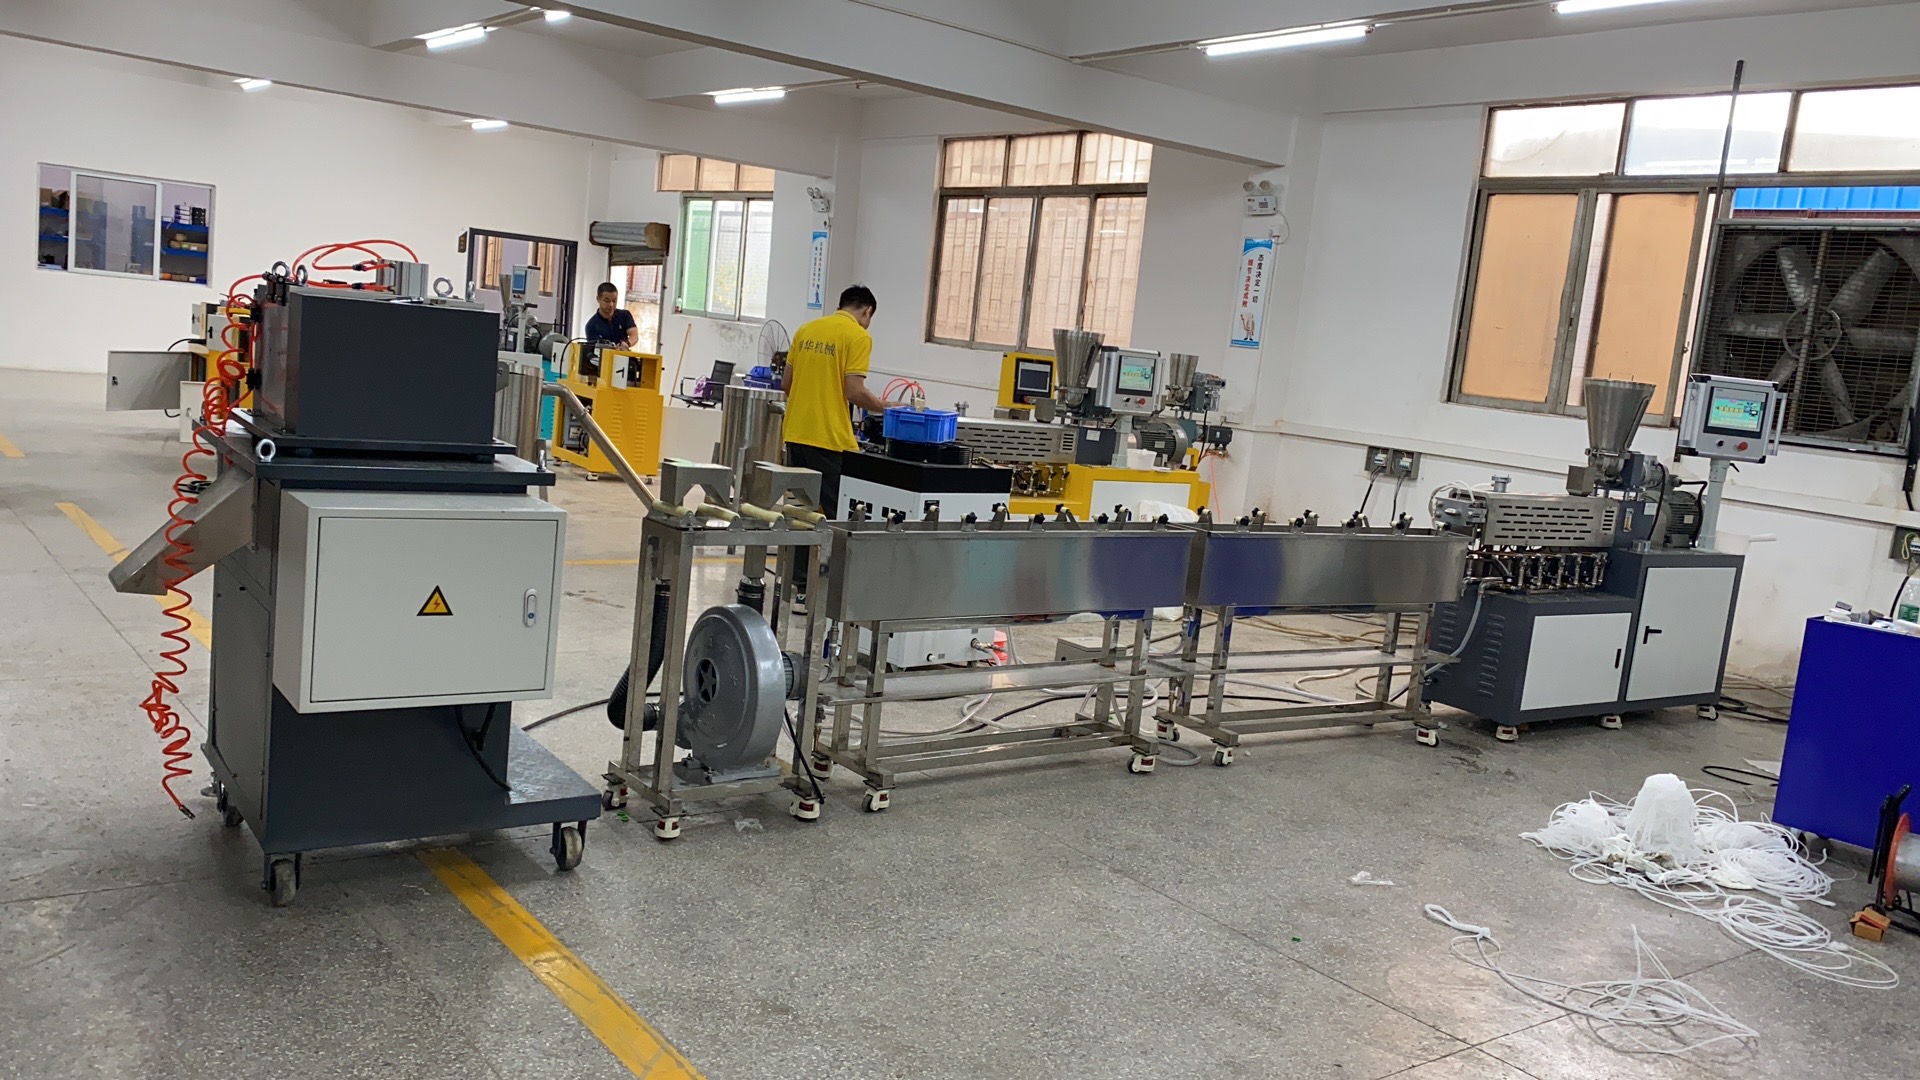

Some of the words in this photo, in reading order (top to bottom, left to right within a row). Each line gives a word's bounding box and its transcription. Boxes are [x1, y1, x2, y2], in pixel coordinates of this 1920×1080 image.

[1252, 254, 1264, 304] 态度决定一切
